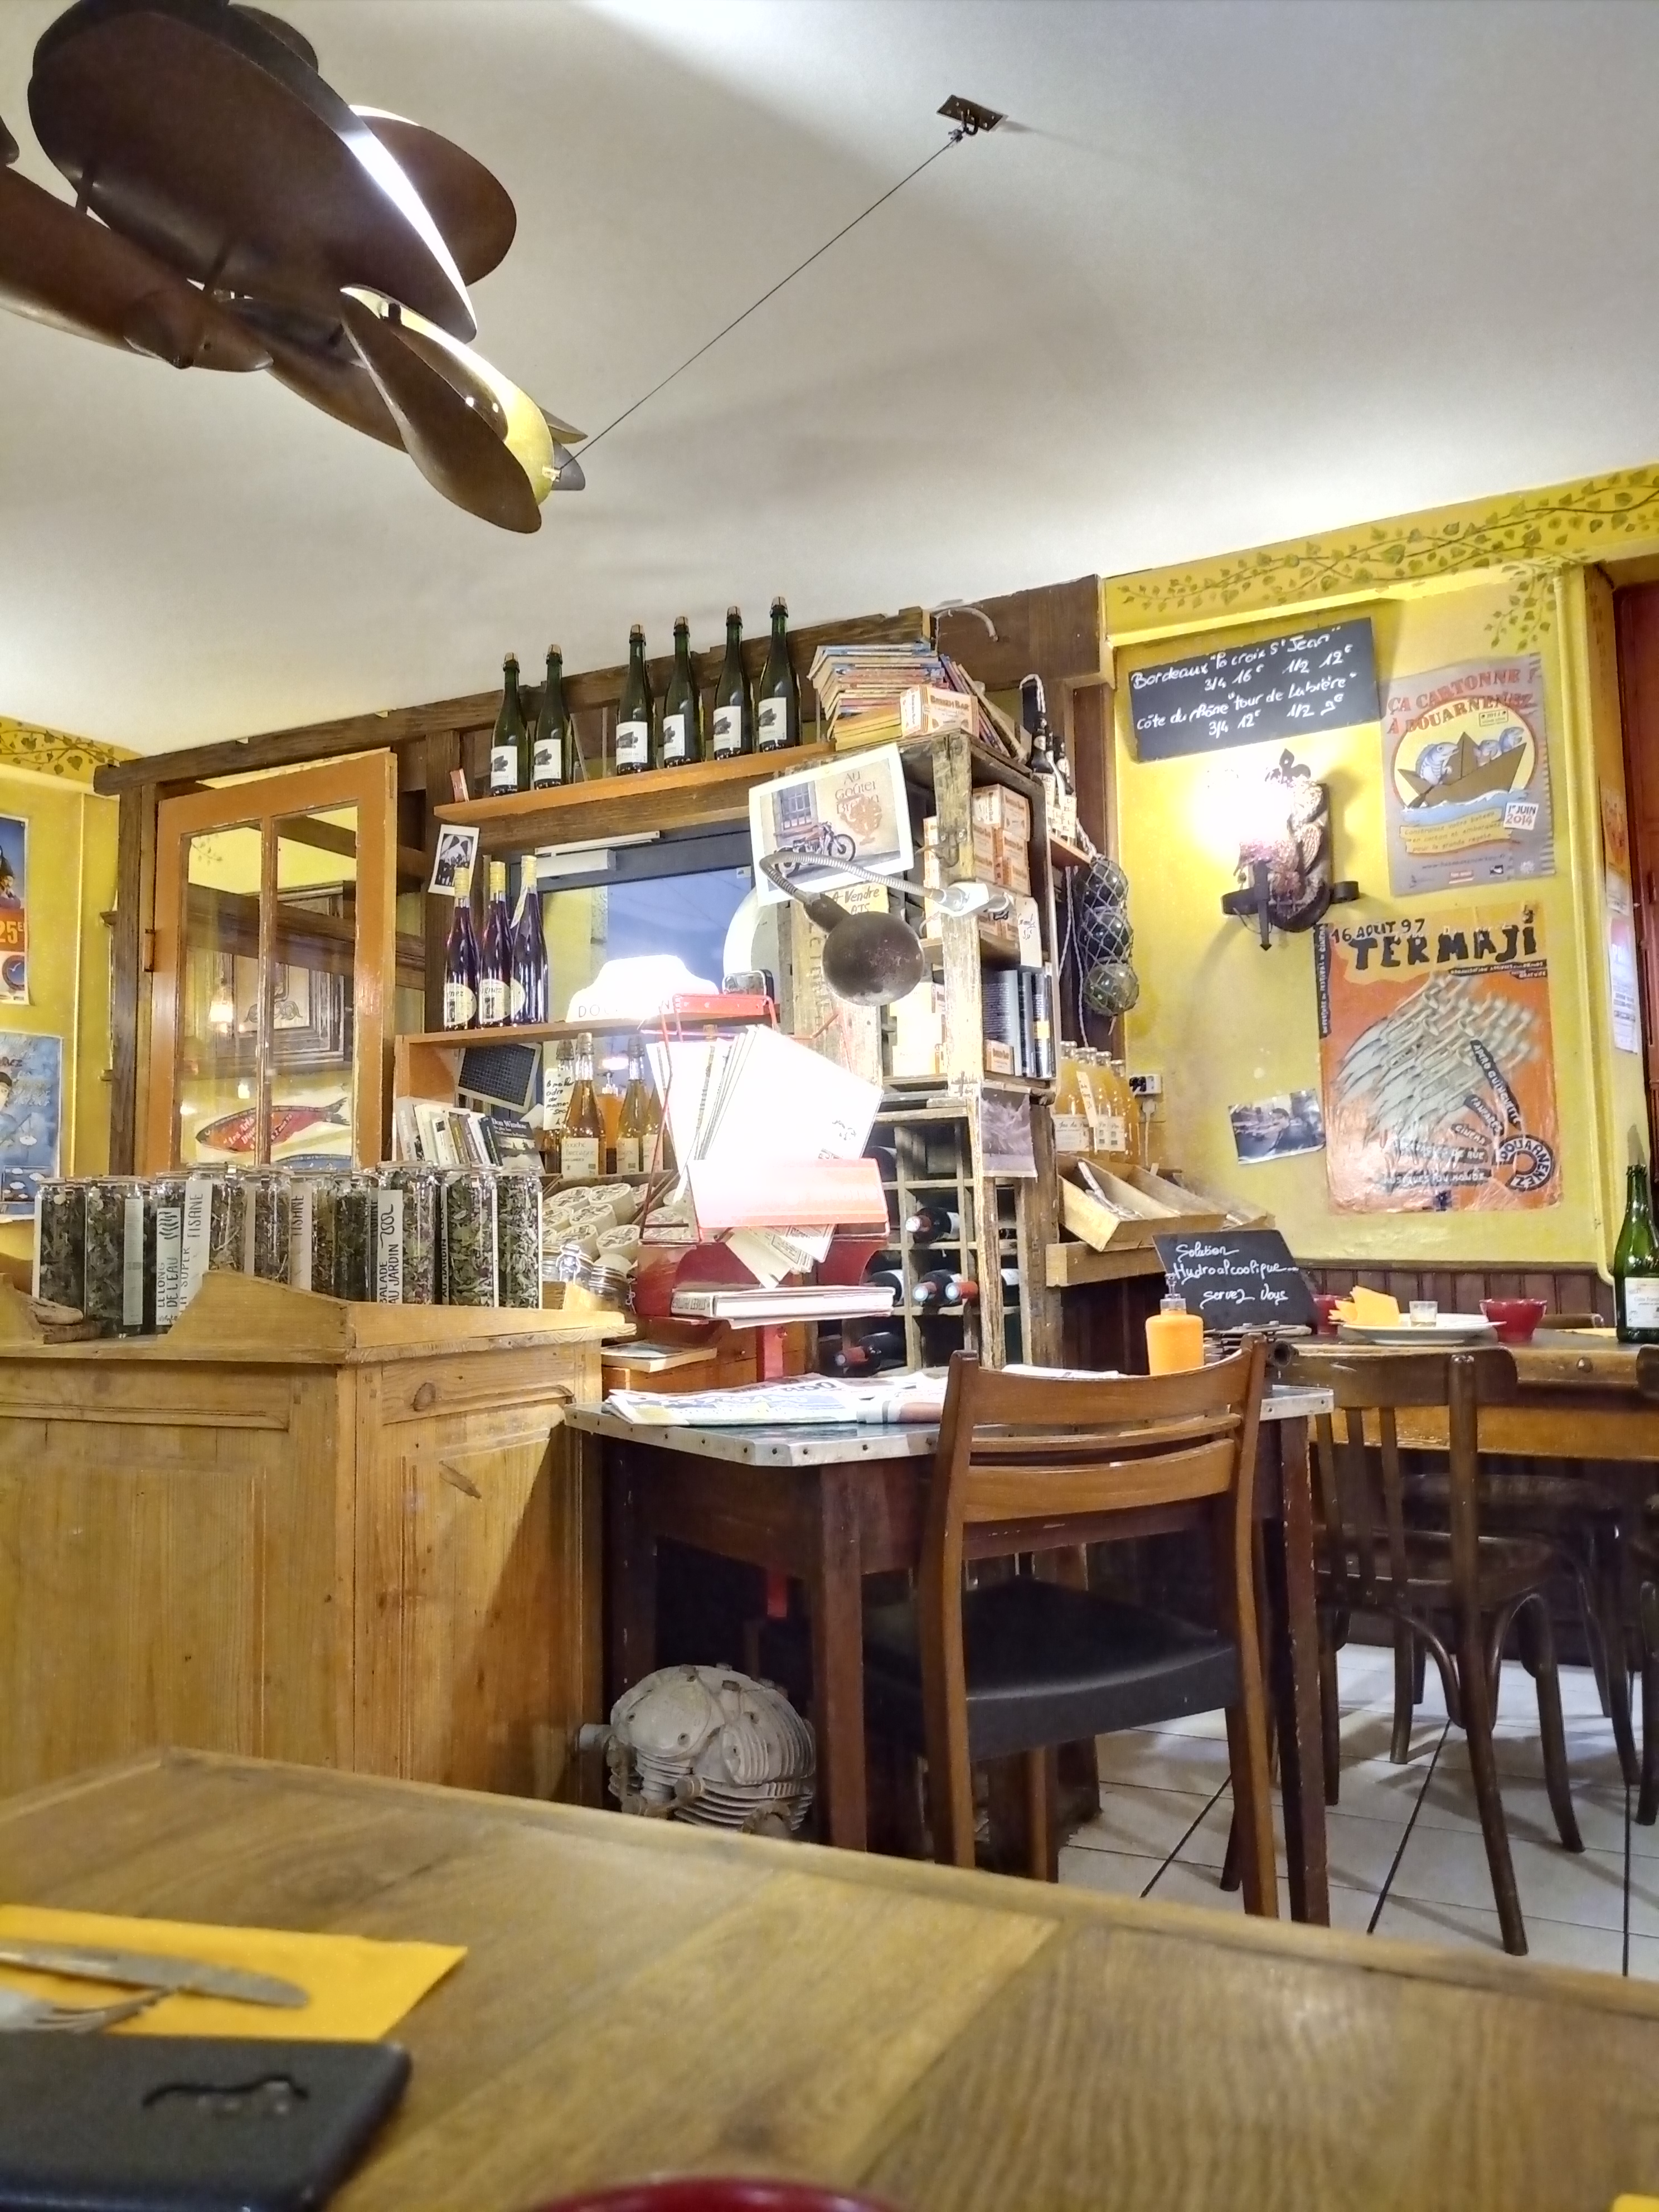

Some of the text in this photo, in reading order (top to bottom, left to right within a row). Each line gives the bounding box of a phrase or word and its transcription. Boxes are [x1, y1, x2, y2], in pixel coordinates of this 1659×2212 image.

[1131, 663, 1208, 689] Bordeaux
[1231, 648, 1266, 666] croix
[1204, 677, 1226, 691] 3/4
[1282, 657, 1310, 674] 1/2
[1170, 707, 1187, 724] du
[1265, 687, 1284, 702] de
[1415, 668, 1521, 709] CARTONNE
[1209, 720, 1229, 739] 3/4
[1286, 703, 1314, 718] 1/2
[843, 770, 861, 785] Au
[1505, 813, 1534, 826] 2014
[1515, 805, 1537, 815] JUIN
[845, 886, 880, 904] Vendre
[1332, 928, 1352, 943] 16
[1401, 918, 1425, 933] 97
[187, 1193, 203, 1238] TISANE
[1175, 1241, 1240, 1263] Solution
[388, 1244, 399, 1303] AU JARDIN
